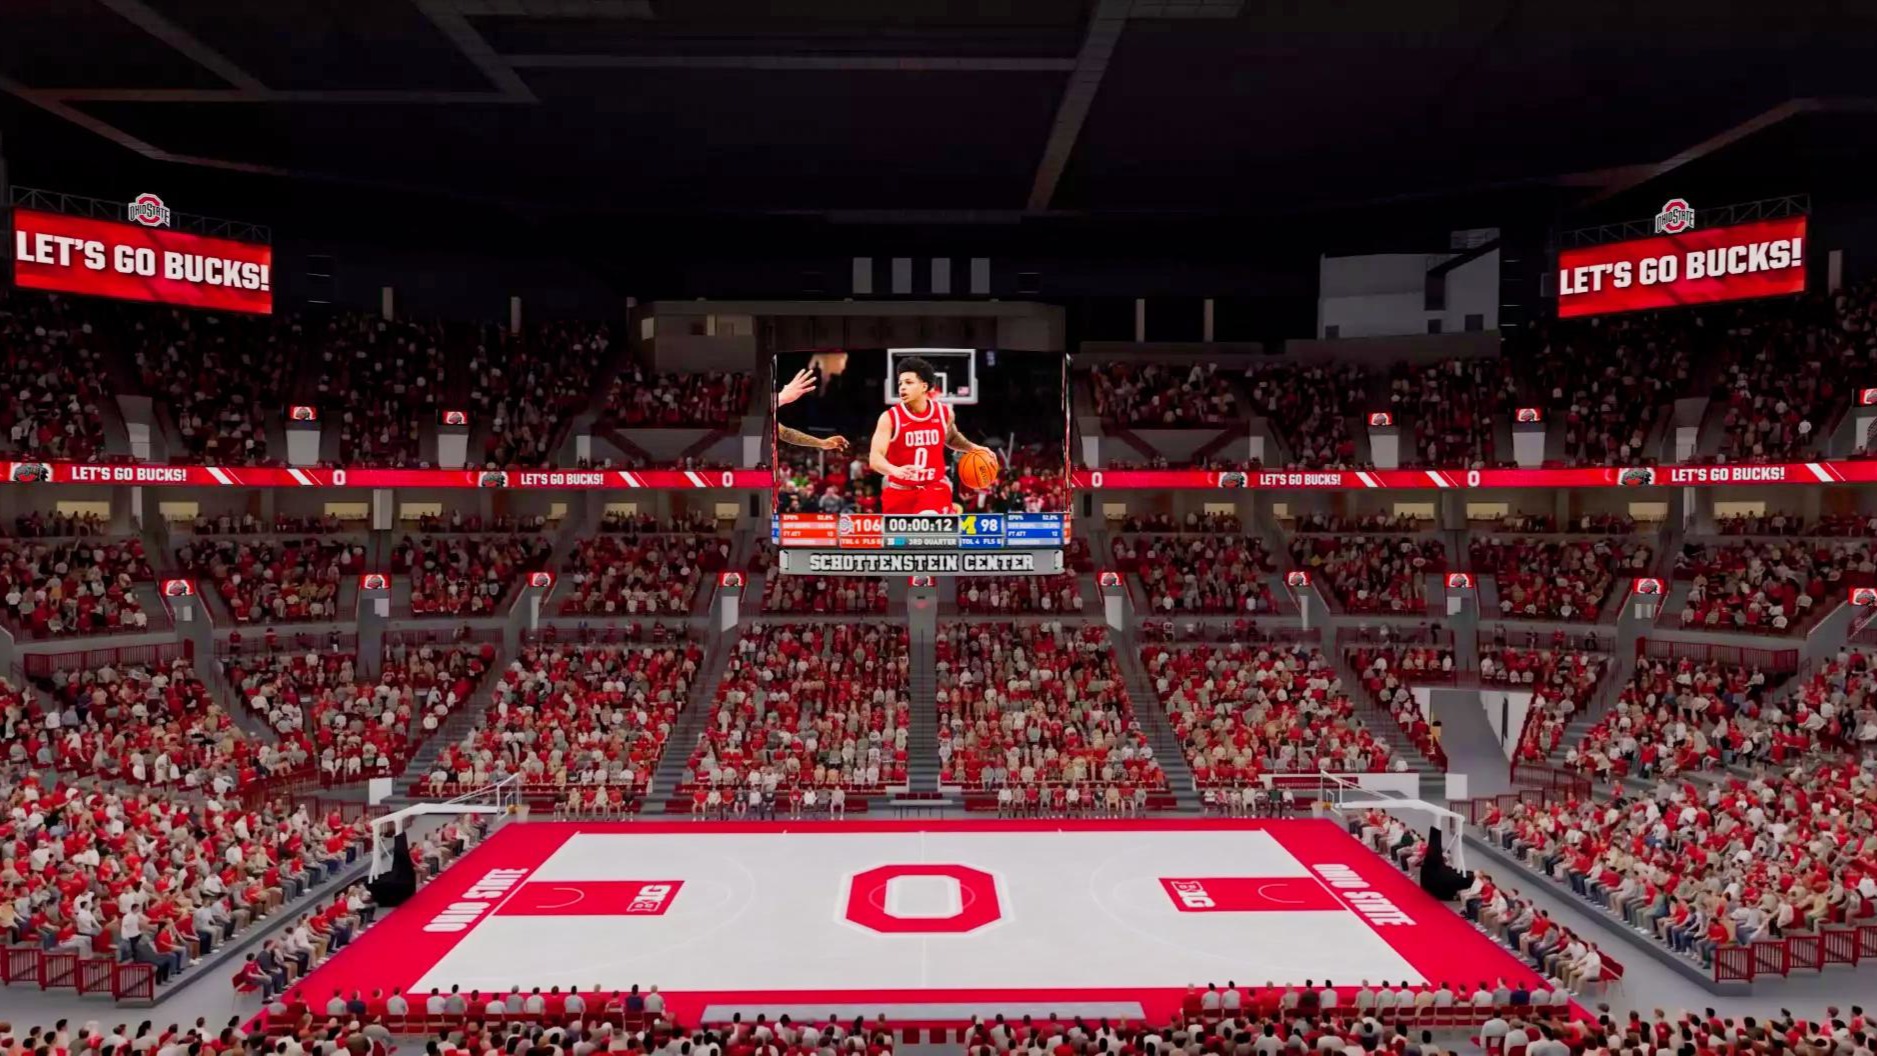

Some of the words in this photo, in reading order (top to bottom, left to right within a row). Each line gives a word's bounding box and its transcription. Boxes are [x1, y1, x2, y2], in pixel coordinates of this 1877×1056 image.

[16, 230, 106, 270] LET'S
[114, 244, 156, 276] GO
[164, 251, 270, 291] BUCKS!
[1560, 261, 1632, 295] LET'S
[1639, 255, 1678, 285] GO
[1686, 238, 1802, 280] BUCKS!
[905, 429, 940, 447] OHIO
[915, 447, 928, 470] 0
[72, 466, 111, 481] LET'S
[114, 467, 133, 481] GO
[137, 467, 187, 482] BUCKS!
[521, 473, 548, 485] LET'S
[550, 473, 565, 485] GO
[567, 473, 604, 485] BUCKS!
[1260, 473, 1287, 486] LET'S
[1289, 473, 1302, 486] GO
[1304, 473, 1341, 486] BUCKS!
[1671, 468, 1707, 482] LET'S
[1710, 467, 1729, 482] GO
[1732, 466, 1785, 481] BUCKS!
[854, 518, 881, 532] 106
[889, 518, 953, 532] 00:00:12
[980, 518, 998, 532] 98
[924, 538, 957, 546] QUARTER
[809, 554, 959, 572] SCHOTTENSTEIN
[963, 554, 1034, 572] CENTER
